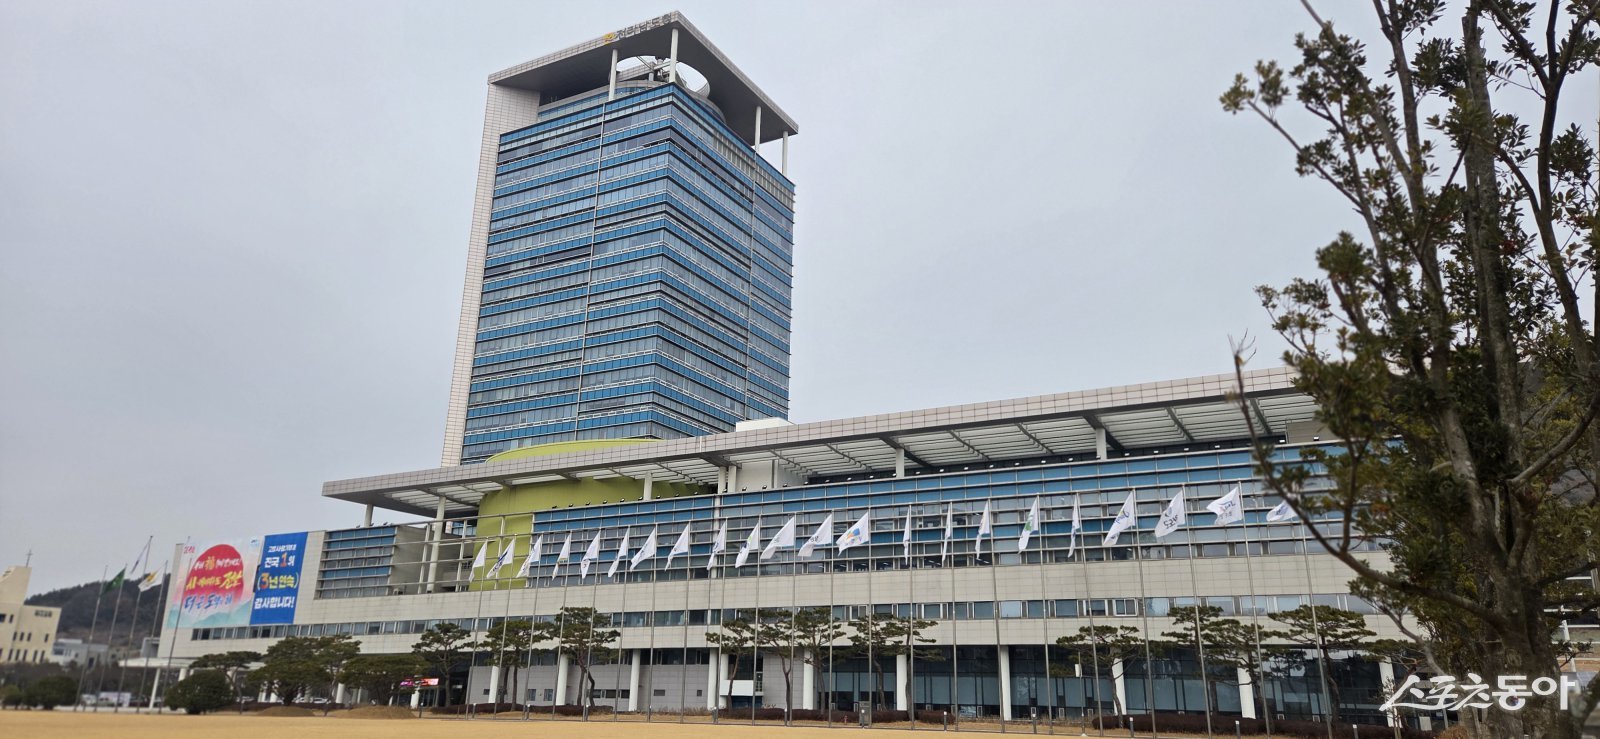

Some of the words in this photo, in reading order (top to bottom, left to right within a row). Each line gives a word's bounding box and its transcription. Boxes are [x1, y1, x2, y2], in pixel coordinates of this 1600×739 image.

[264, 556, 279, 568] 전국
[281, 553, 295, 568] 1위
[254, 597, 295, 609] 감사합니다!
